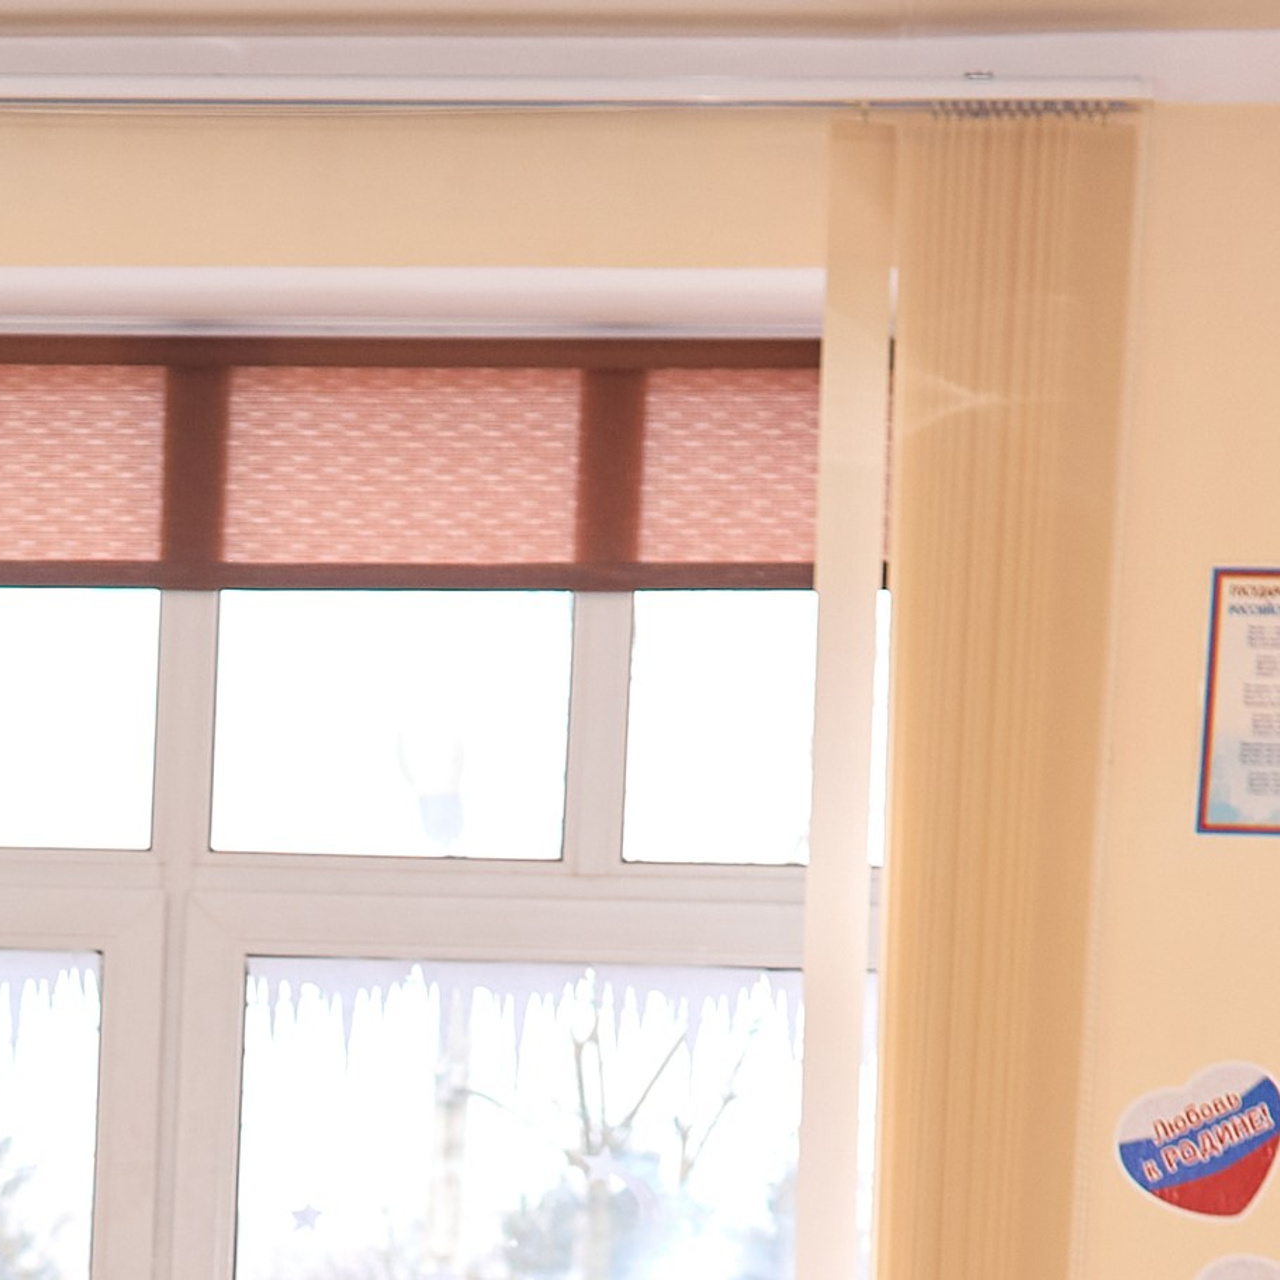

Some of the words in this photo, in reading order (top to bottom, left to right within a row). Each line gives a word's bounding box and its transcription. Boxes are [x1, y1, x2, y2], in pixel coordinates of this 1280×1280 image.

[1143, 1160, 1163, 1182] к
[1161, 1103, 1273, 1172] РОДИНЕ!
[1154, 1092, 1242, 1146] Любовь
